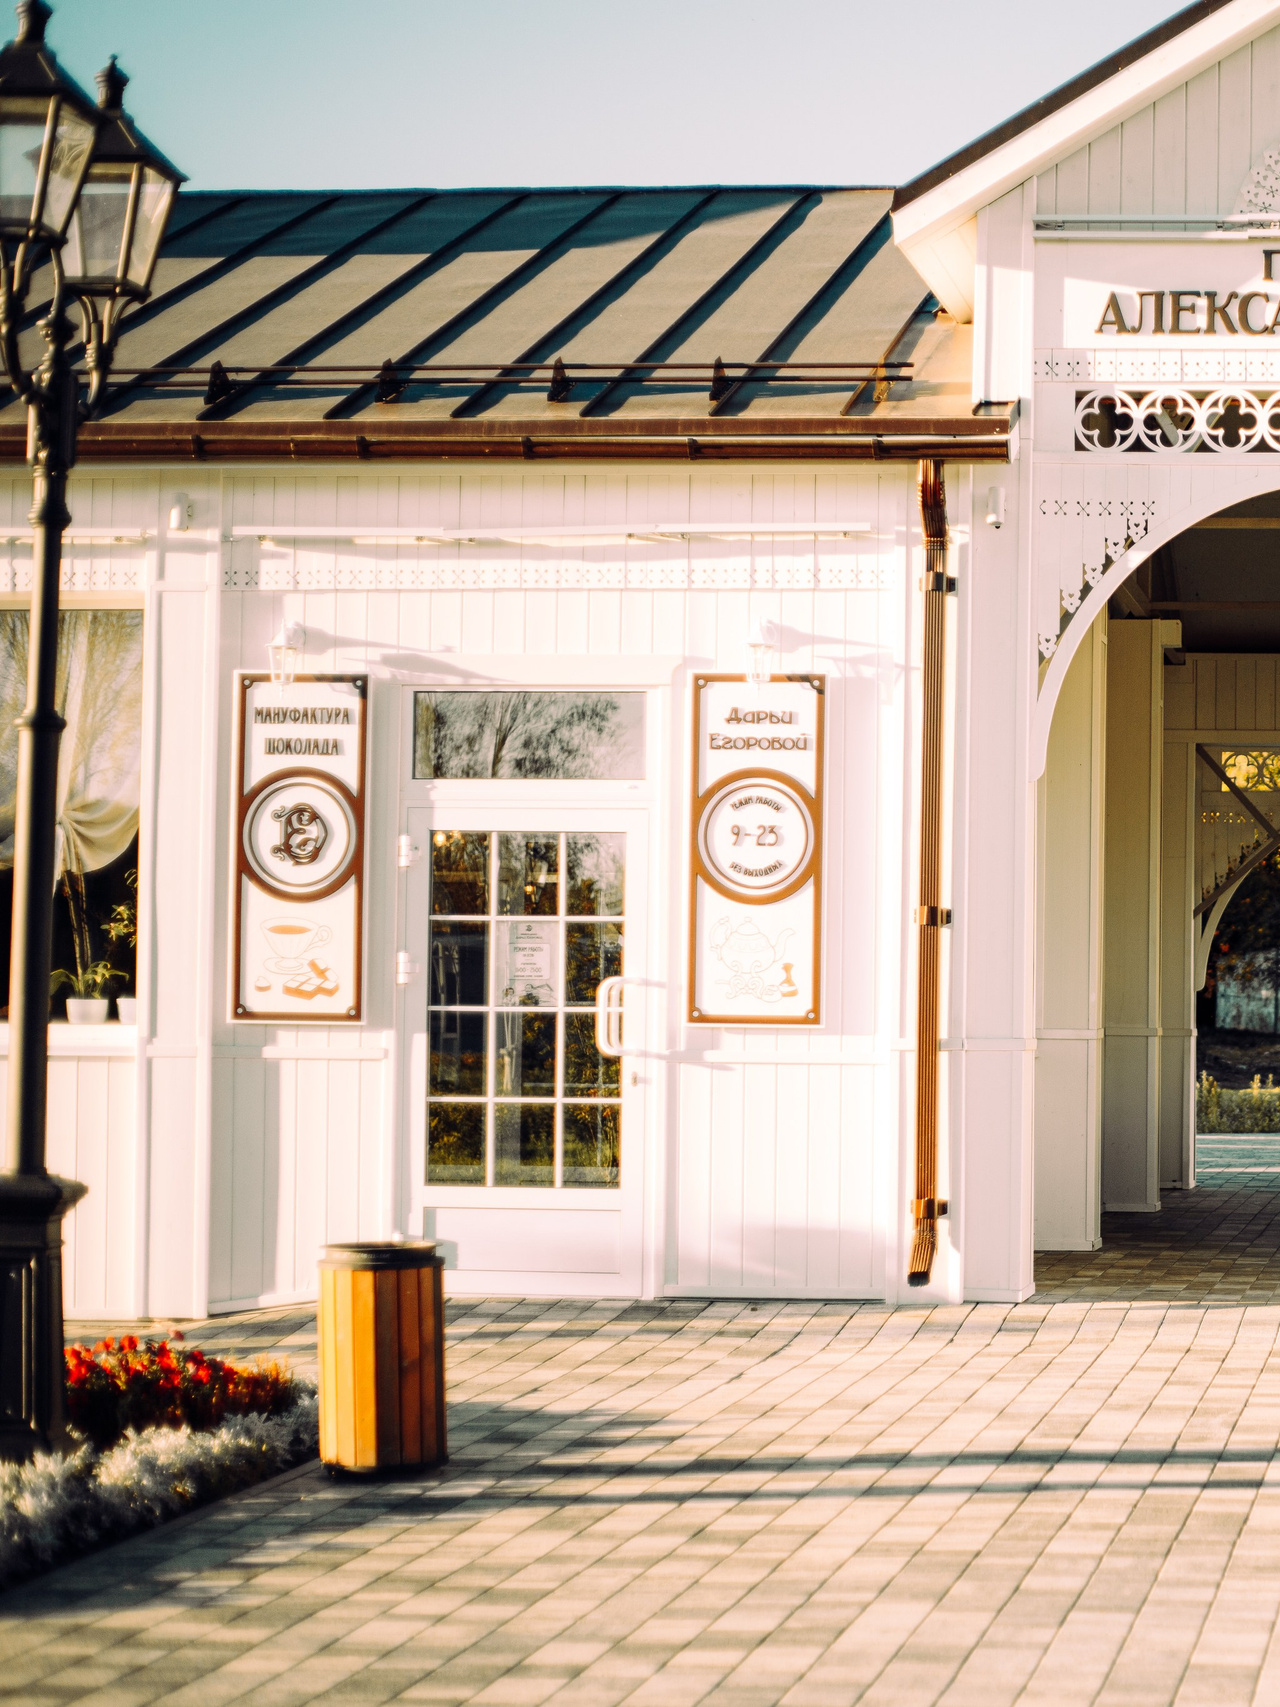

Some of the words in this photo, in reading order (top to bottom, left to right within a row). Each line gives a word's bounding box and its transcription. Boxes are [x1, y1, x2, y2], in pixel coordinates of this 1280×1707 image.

[254, 706, 350, 725] МАНУФАКТУРА
[724, 706, 793, 724] Дарьи
[264, 737, 339, 756] ШОКОЛАДА
[708, 732, 808, 750] Егоровой
[730, 796, 754, 810] РЕЖИМ
[755, 796, 782, 812] РАБОТЫ
[729, 861, 743, 873] БЕЗ
[743, 859, 784, 877] ВЫХОДНЫХ
